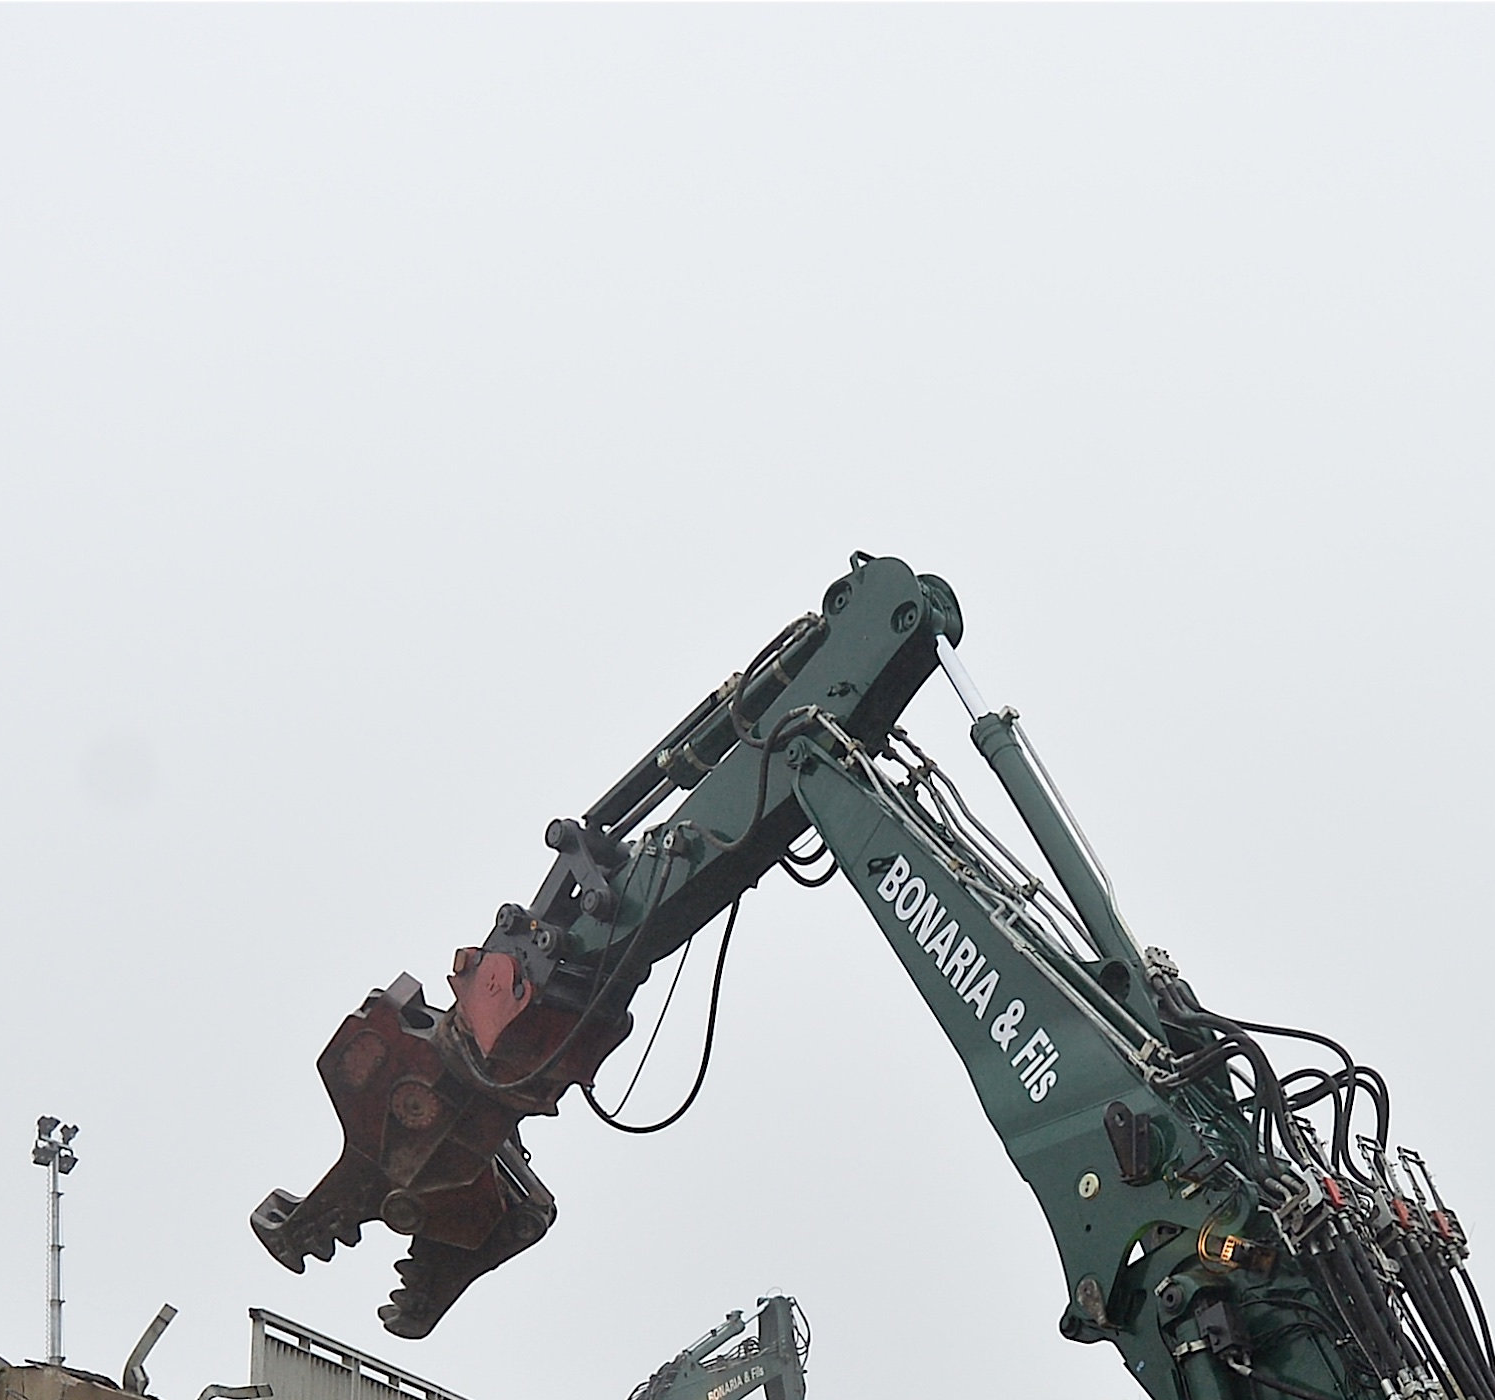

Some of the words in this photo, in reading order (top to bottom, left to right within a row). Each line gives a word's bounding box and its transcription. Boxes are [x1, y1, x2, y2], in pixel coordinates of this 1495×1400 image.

[877, 854, 1001, 1020] BONARIA
[990, 999, 1025, 1052] &
[1011, 1027, 1060, 1103] Fils
[743, 1371, 751, 1383] &
[751, 1365, 765, 1380] Fils
